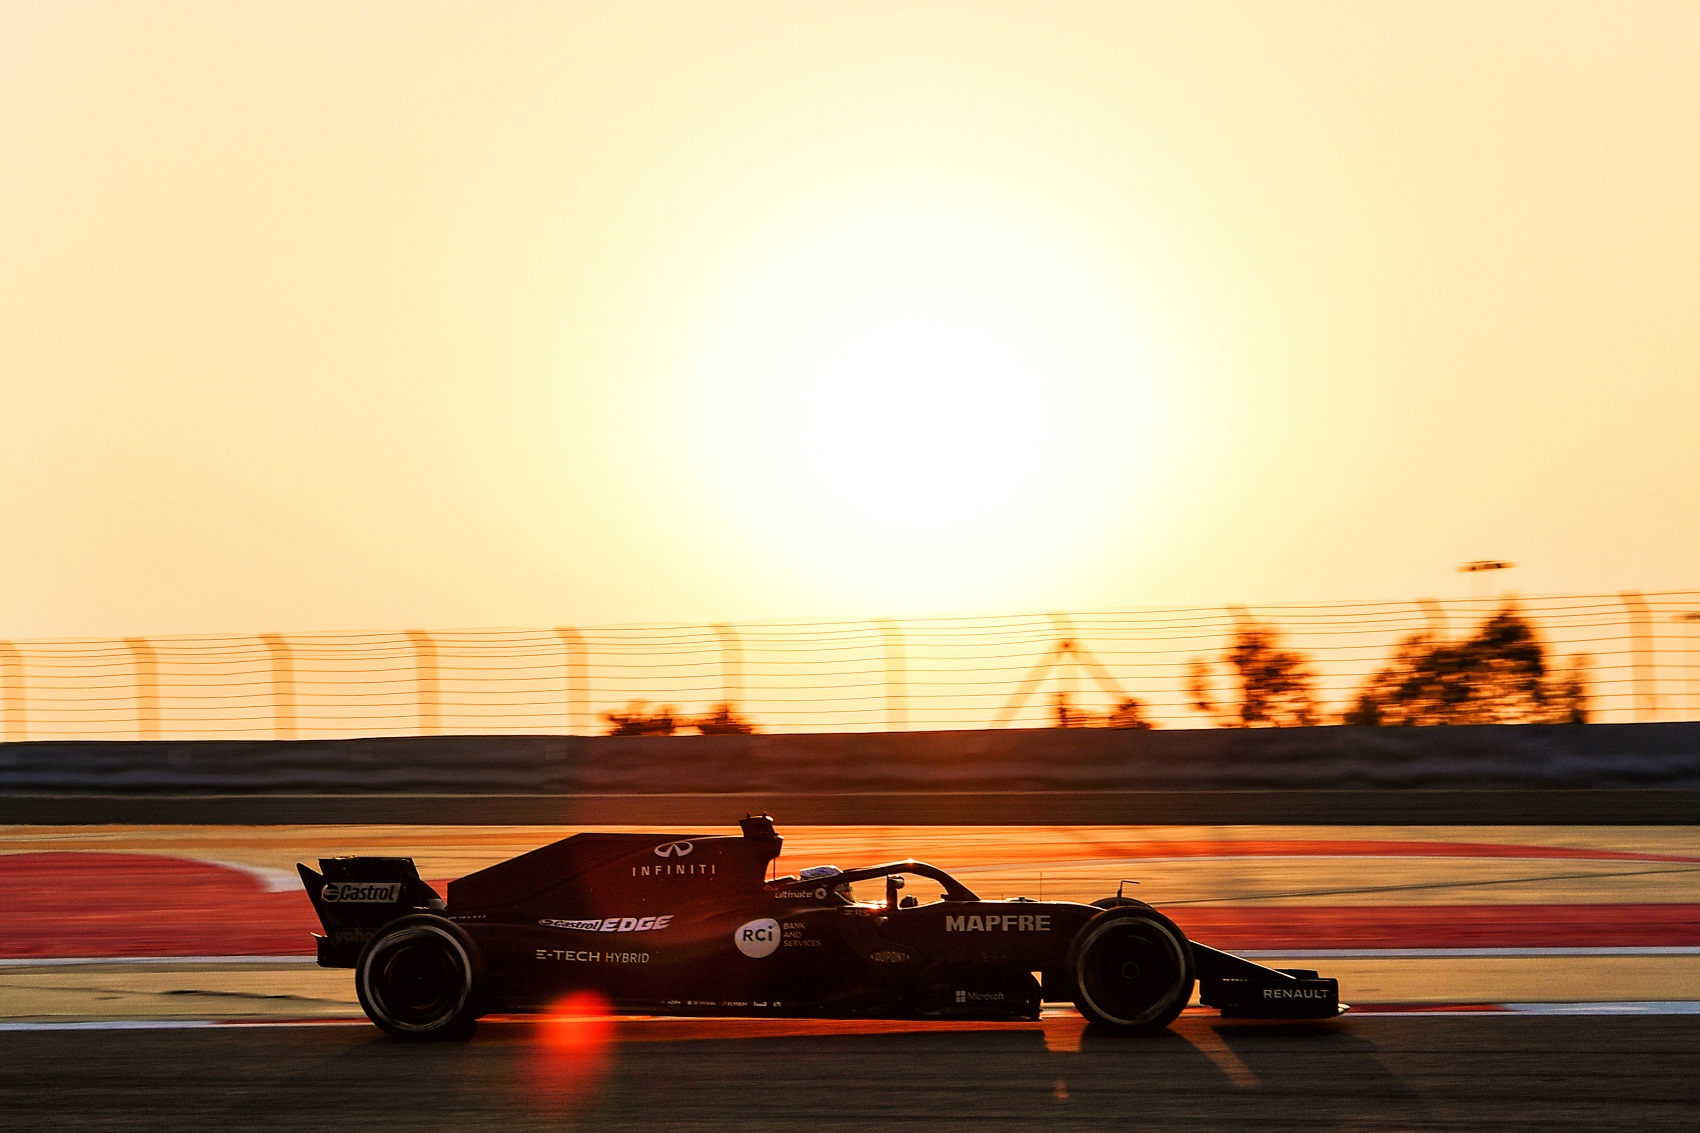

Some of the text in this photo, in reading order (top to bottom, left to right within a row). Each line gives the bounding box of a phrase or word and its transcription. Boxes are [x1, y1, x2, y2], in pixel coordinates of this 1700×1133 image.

[632, 864, 716, 877] INFINITI
[340, 884, 395, 901] Castrol
[775, 889, 813, 899] ultimate
[553, 914, 674, 932] Castrol EDGE
[783, 922, 806, 930] BANK
[945, 914, 1051, 932] MAPFRE
[783, 931, 802, 939] AND
[783, 939, 822, 947] SERVICES
[536, 949, 649, 964] E-TECH HYBRID
[968, 991, 1005, 1001] Microsoft
[1262, 988, 1330, 1000] RENAULT
